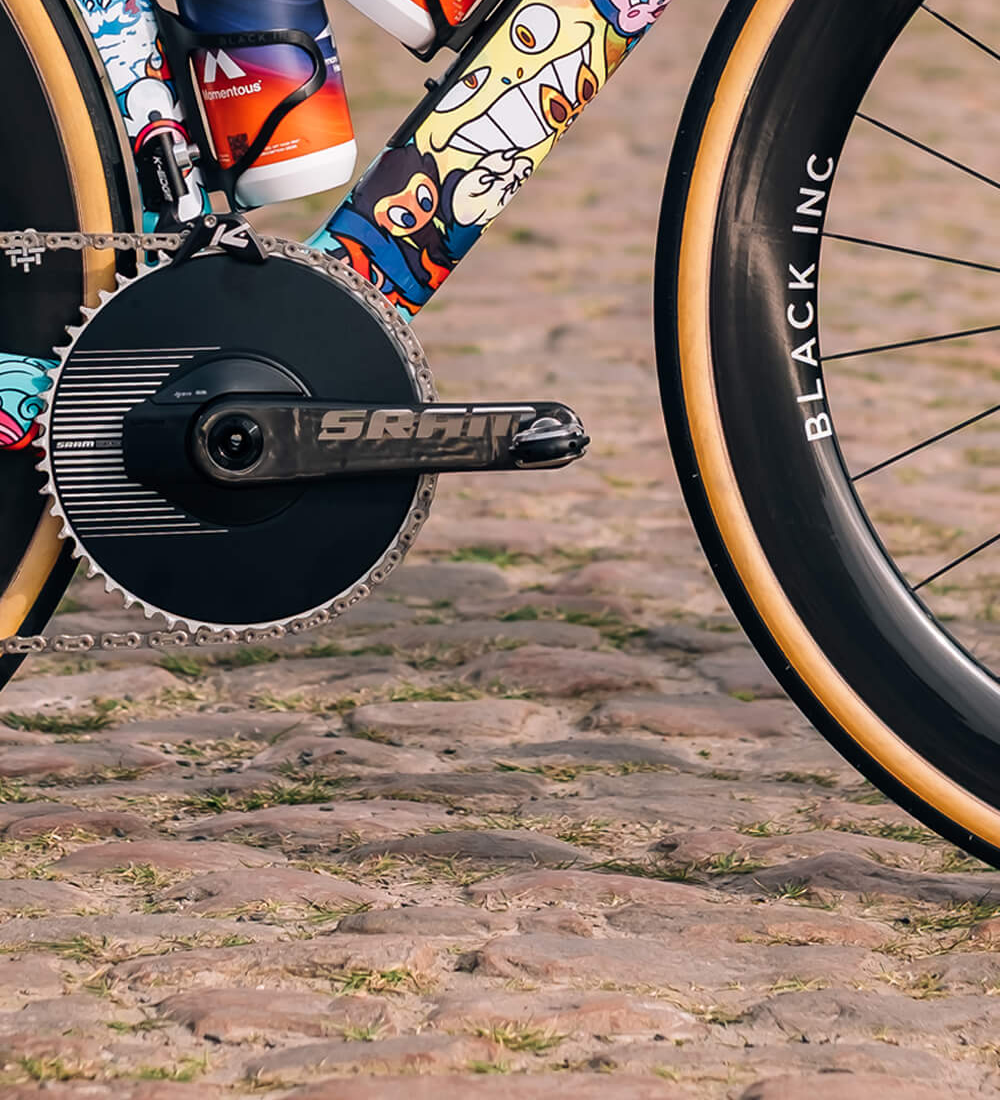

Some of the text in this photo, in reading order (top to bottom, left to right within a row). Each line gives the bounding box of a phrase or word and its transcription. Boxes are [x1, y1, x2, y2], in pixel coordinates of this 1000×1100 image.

[787, 153, 834, 442] BLACK INC
[318, 406, 536, 441] SRAM
[56, 440, 95, 449] SRAM
